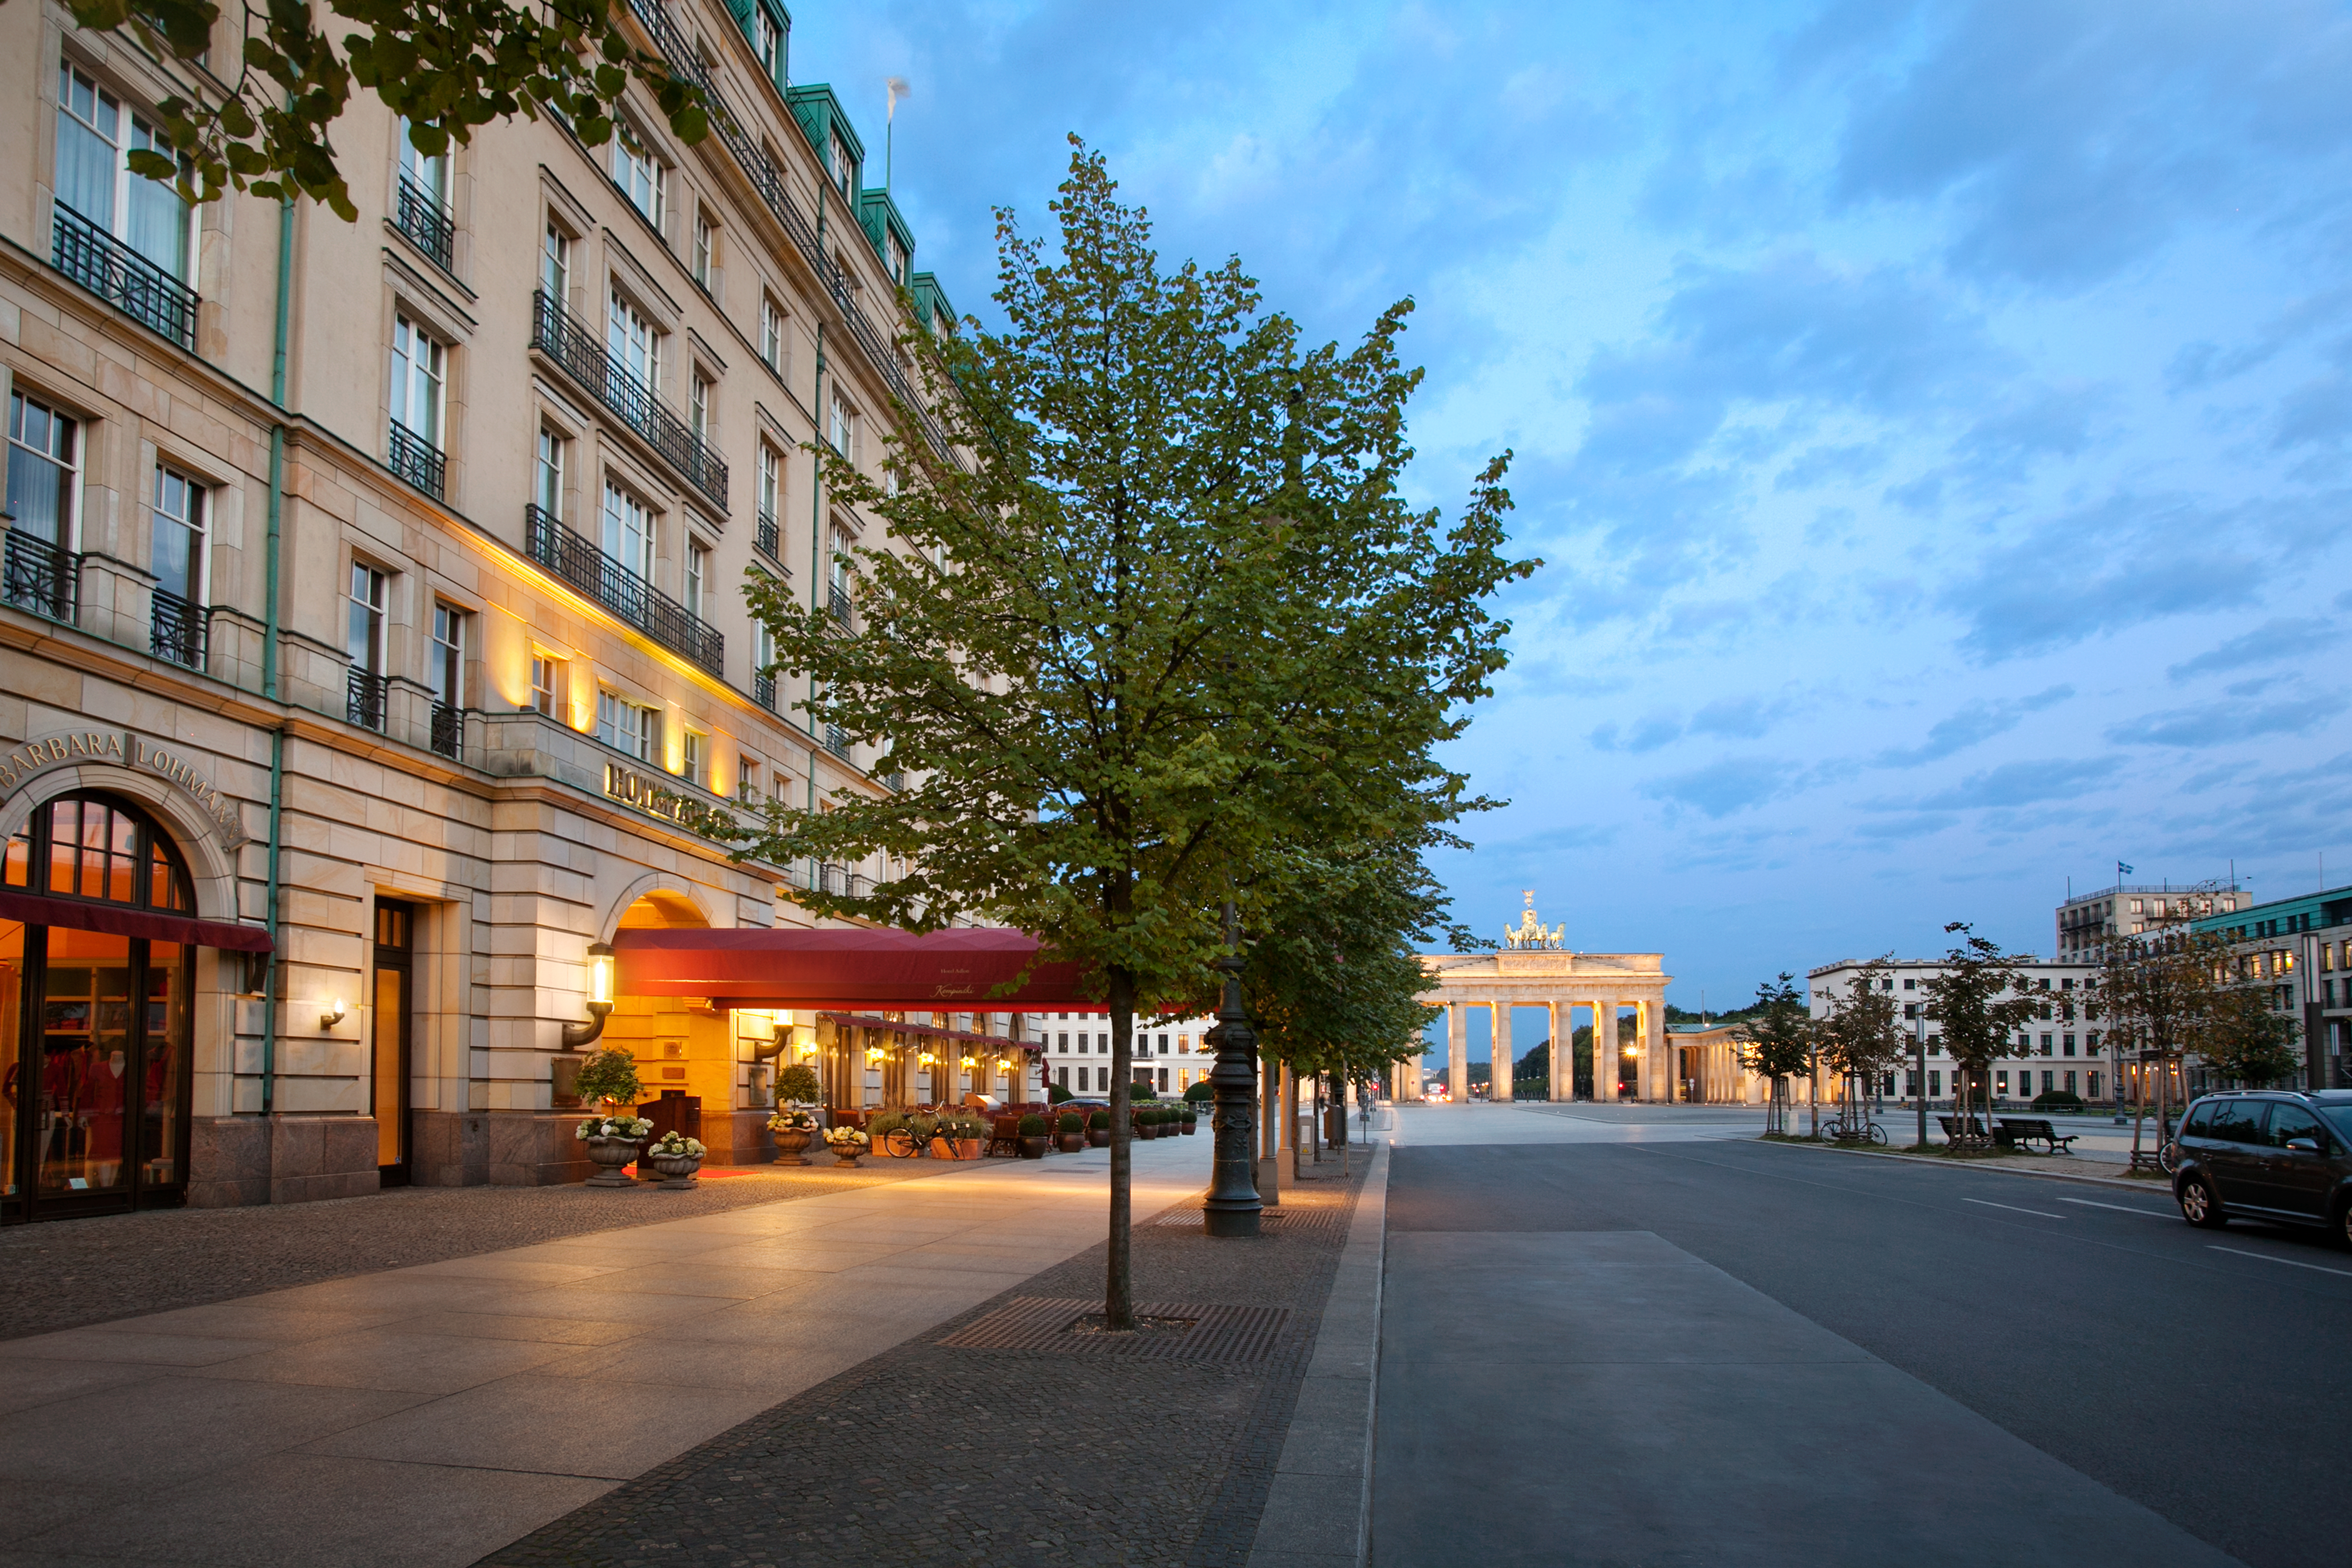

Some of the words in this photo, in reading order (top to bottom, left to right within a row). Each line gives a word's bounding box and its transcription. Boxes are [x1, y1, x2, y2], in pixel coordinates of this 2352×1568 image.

[0, 733, 123, 788] BARBARA
[139, 742, 242, 839] LOHMANN
[929, 983, 975, 998] Kempinski
